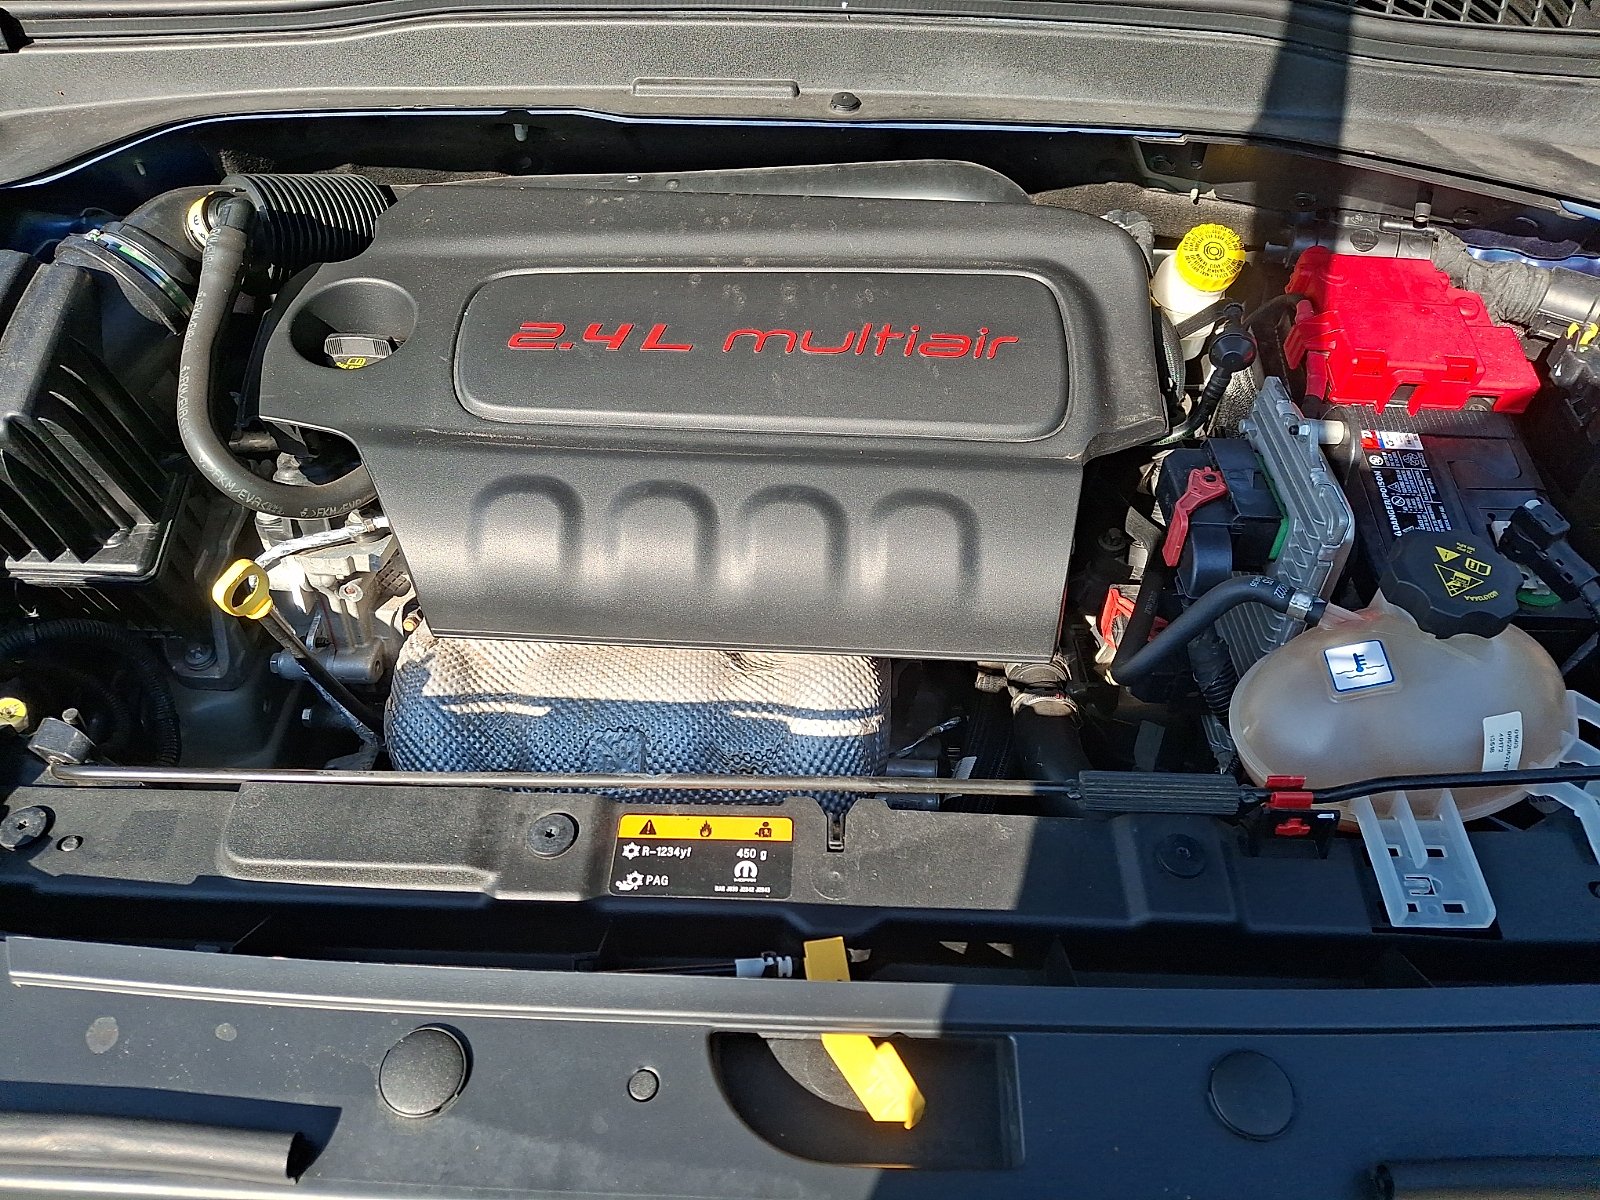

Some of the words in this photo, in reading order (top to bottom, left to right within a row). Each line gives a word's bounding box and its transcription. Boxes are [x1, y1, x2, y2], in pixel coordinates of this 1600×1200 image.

[507, 322, 692, 352] 2.4L
[722, 325, 1020, 360] multiair
[642, 846, 692, 859] R-1234yf
[736, 849, 757, 859] 450
[759, 850, 768, 860] g
[645, 875, 669, 886] PAG
